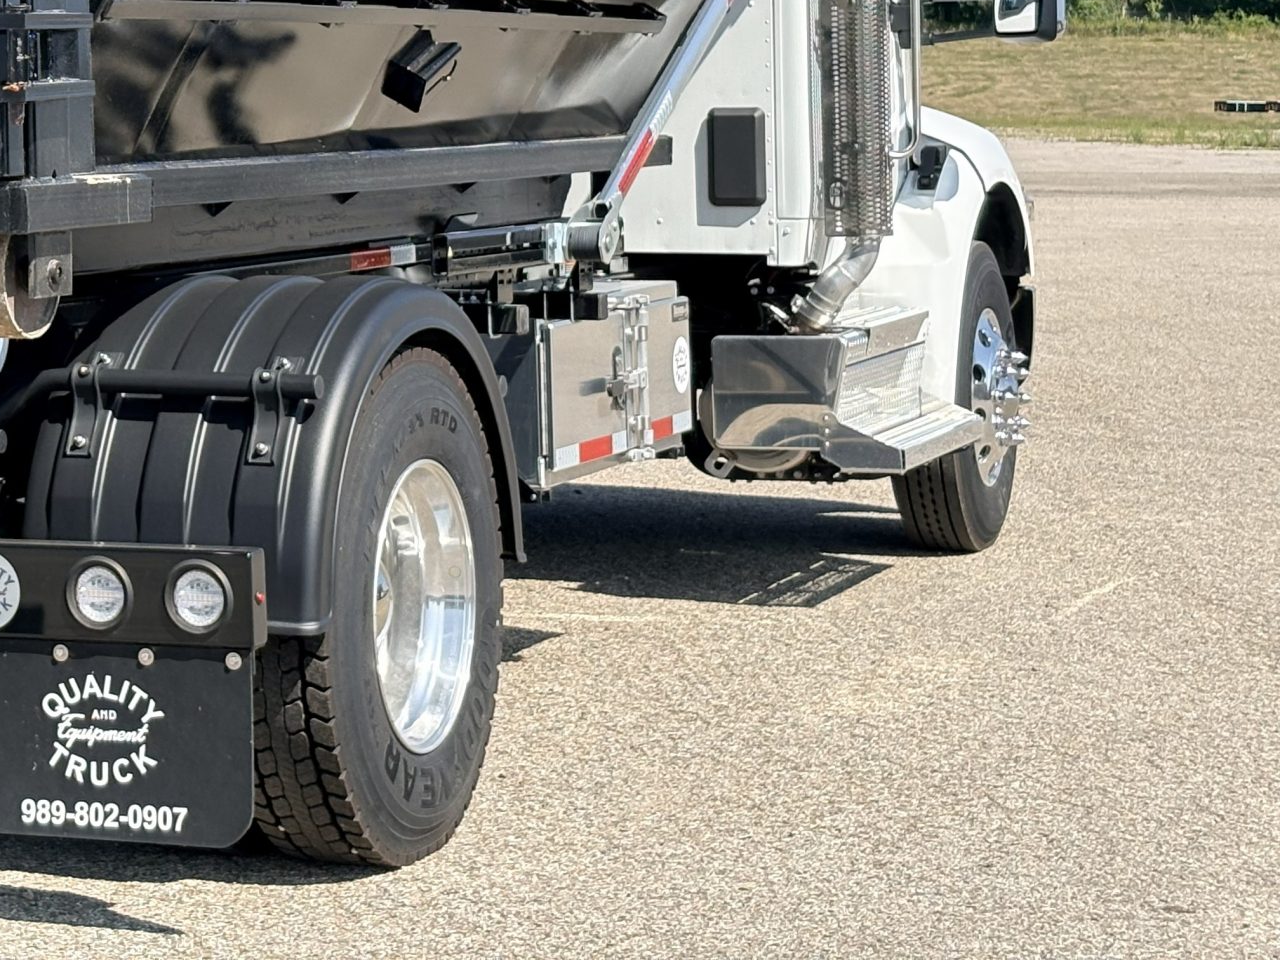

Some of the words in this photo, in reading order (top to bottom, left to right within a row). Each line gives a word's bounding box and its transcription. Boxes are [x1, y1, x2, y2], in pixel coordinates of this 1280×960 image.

[41, 674, 165, 723] QUALITY
[91, 709, 118, 720] AND
[57, 712, 149, 748] Equipment
[48, 741, 158, 787] TRUCK
[20, 798, 189, 832] 989-802-0907
